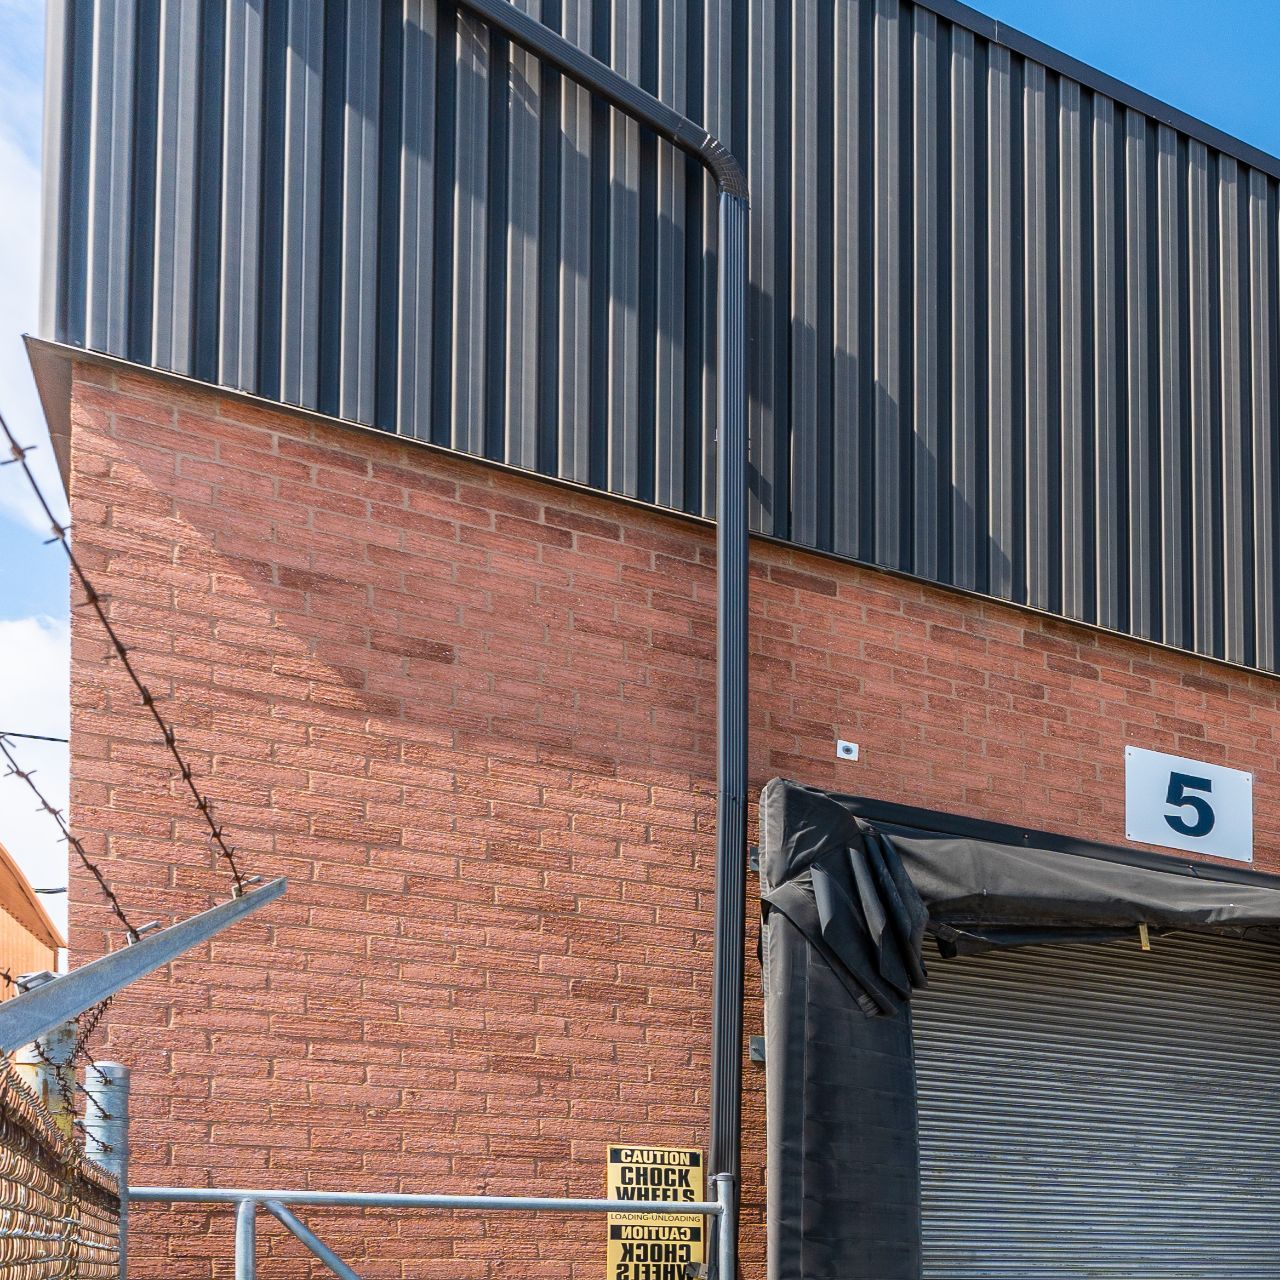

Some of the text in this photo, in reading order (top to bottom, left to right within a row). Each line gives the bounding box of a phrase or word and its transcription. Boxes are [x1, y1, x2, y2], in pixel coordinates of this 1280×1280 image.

[1163, 771, 1216, 838] 5
[620, 1149, 691, 1166] CAUTION
[620, 1166, 692, 1188] CHOCK
[615, 1186, 695, 1202] WHEELS
